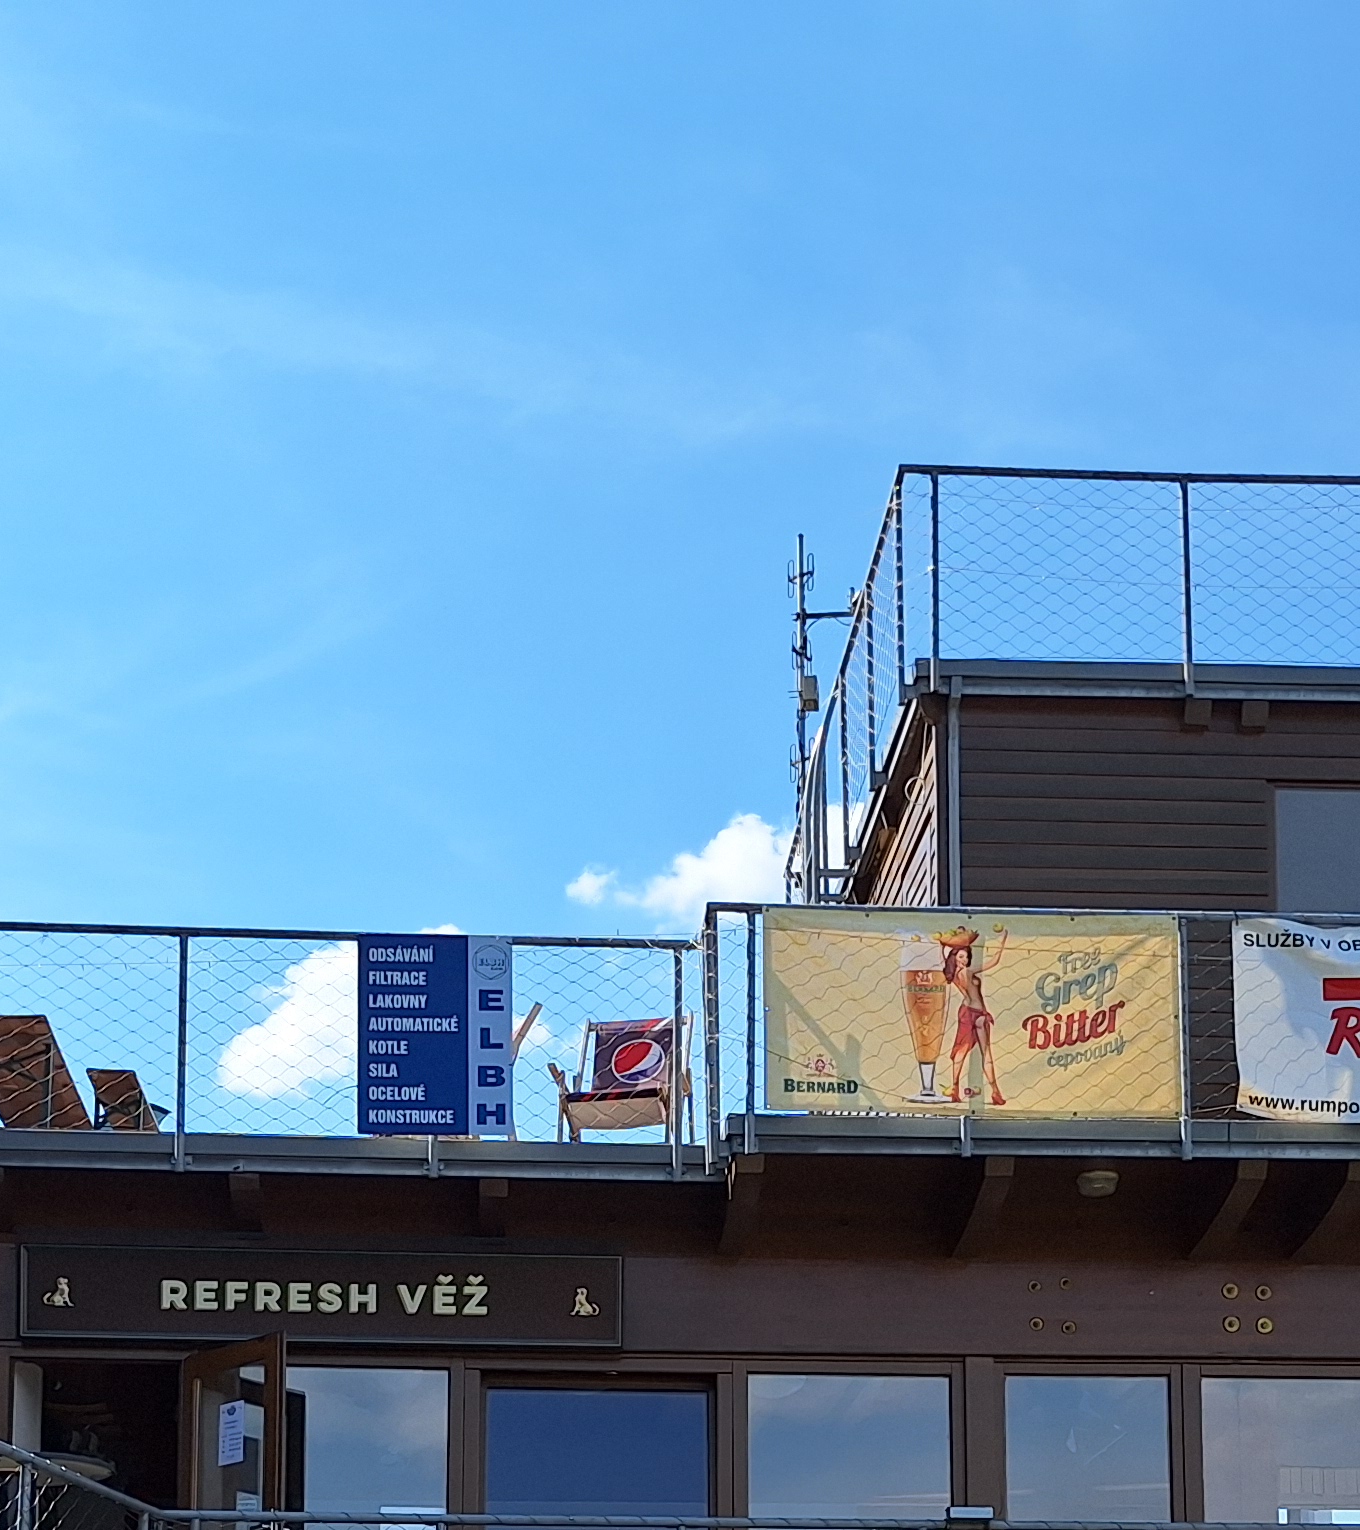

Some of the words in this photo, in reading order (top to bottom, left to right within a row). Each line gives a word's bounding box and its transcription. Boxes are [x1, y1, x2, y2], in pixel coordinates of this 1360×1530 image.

[1243, 929, 1315, 948] SLUŽBY
[368, 945, 434, 962] ODSÁVÁNÍ
[368, 971, 427, 986] FILTRACE
[1035, 966, 1118, 1014] Grep
[368, 994, 427, 1009] LAKOVNY
[368, 1015, 459, 1032] AUTOMATICKÉ
[1022, 1000, 1125, 1050] Bitter
[368, 1040, 408, 1055] KOTLE
[368, 1063, 398, 1078] SILA
[368, 1084, 426, 1101] OCELOVÉ
[783, 1079, 859, 1094] BERNARD
[368, 1109, 454, 1124] KONSTRUKCE
[160, 1279, 378, 1314] REFRESH
[397, 1273, 489, 1316] VĚŽ
